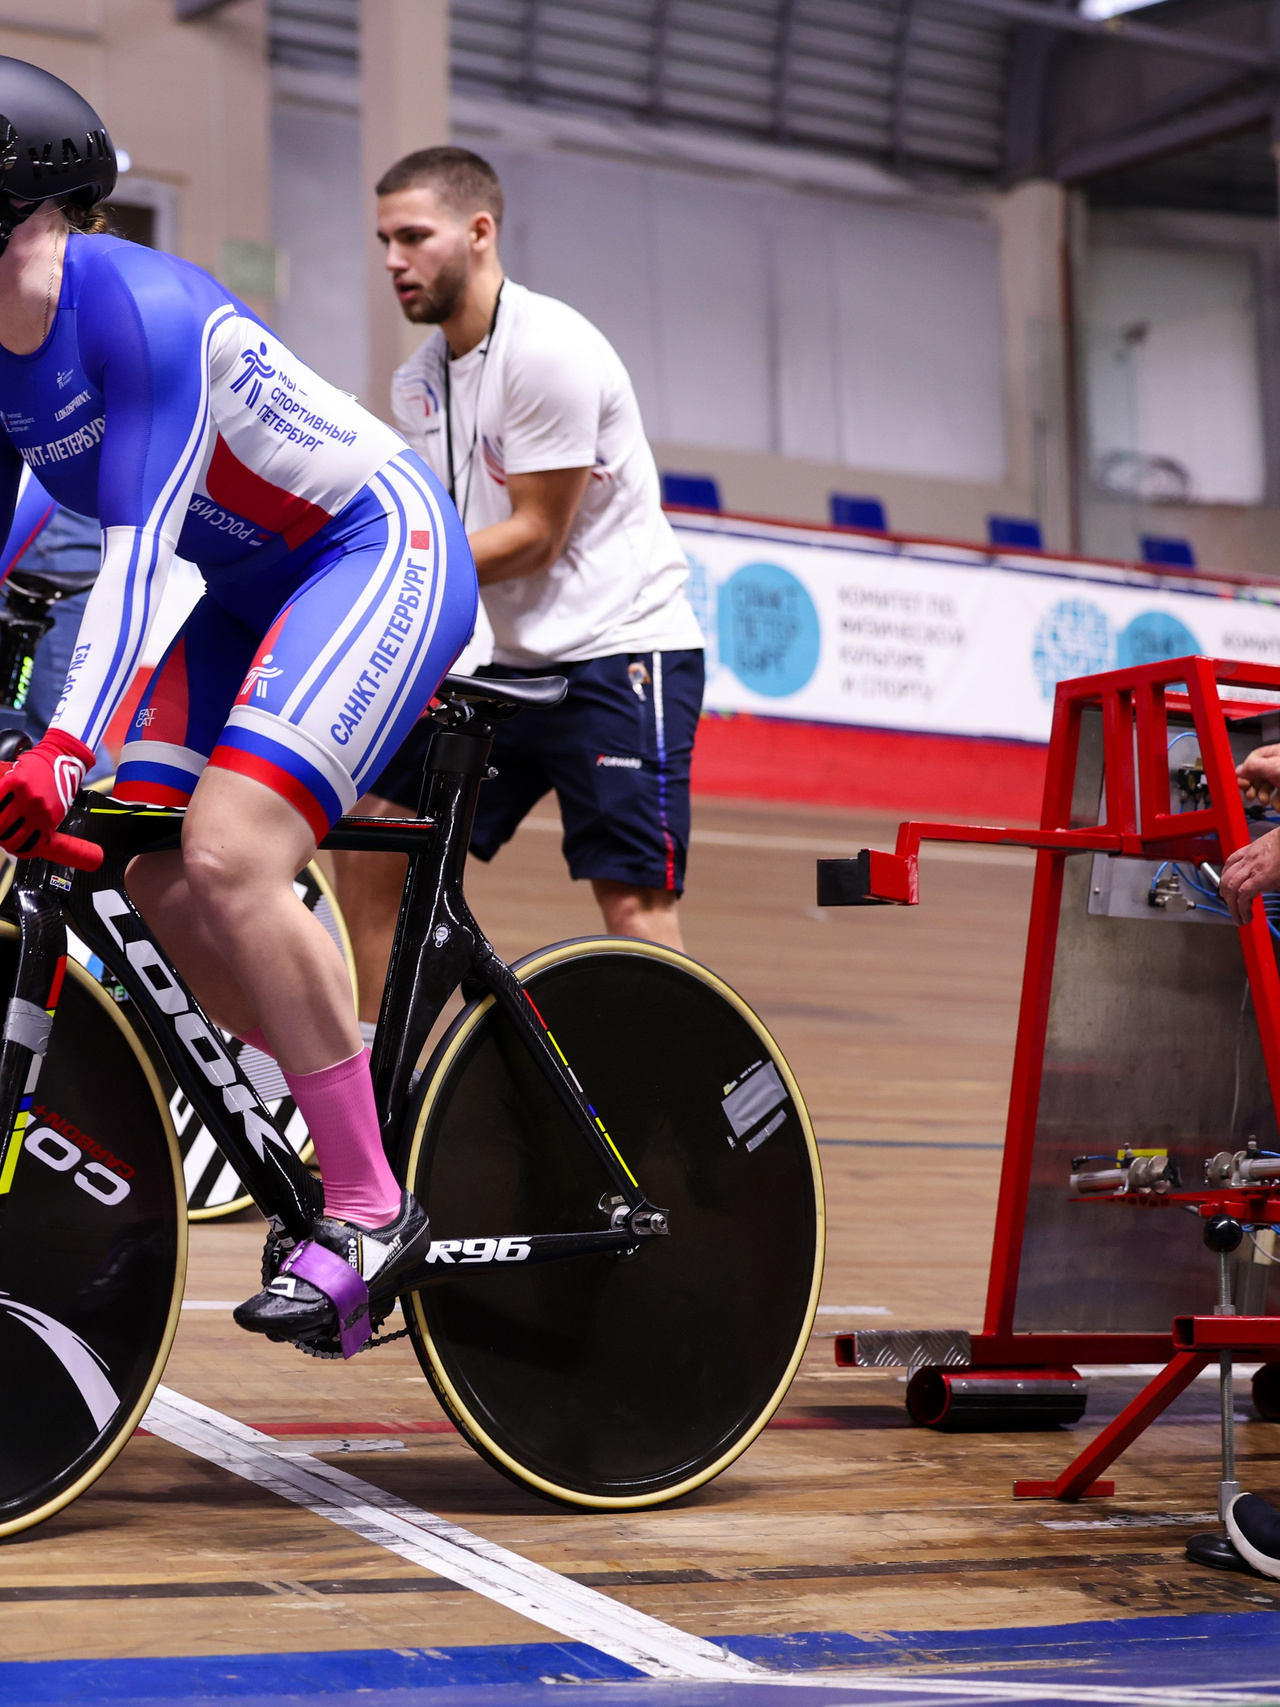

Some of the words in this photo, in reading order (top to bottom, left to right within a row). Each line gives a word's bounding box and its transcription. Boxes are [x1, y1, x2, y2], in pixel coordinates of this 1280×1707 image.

[20, 416, 106, 467] НКТ-ПЕТЕРБУР
[256, 403, 324, 453] ПЕТЕРБУРГ
[269, 386, 359, 447] СПОРТИВНЫЙ
[188, 498, 255, 542] РОССИЯ
[330, 557, 427, 746] САНКТ-ПЕТЕРБУРГ
[135, 717, 155, 727] CAT
[137, 708, 157, 719] FAT
[92, 889, 292, 1163] LOOK
[34, 1104, 136, 1180] CARBON+
[348, 1237, 357, 1271] ERO+
[425, 1236, 533, 1264] R96
